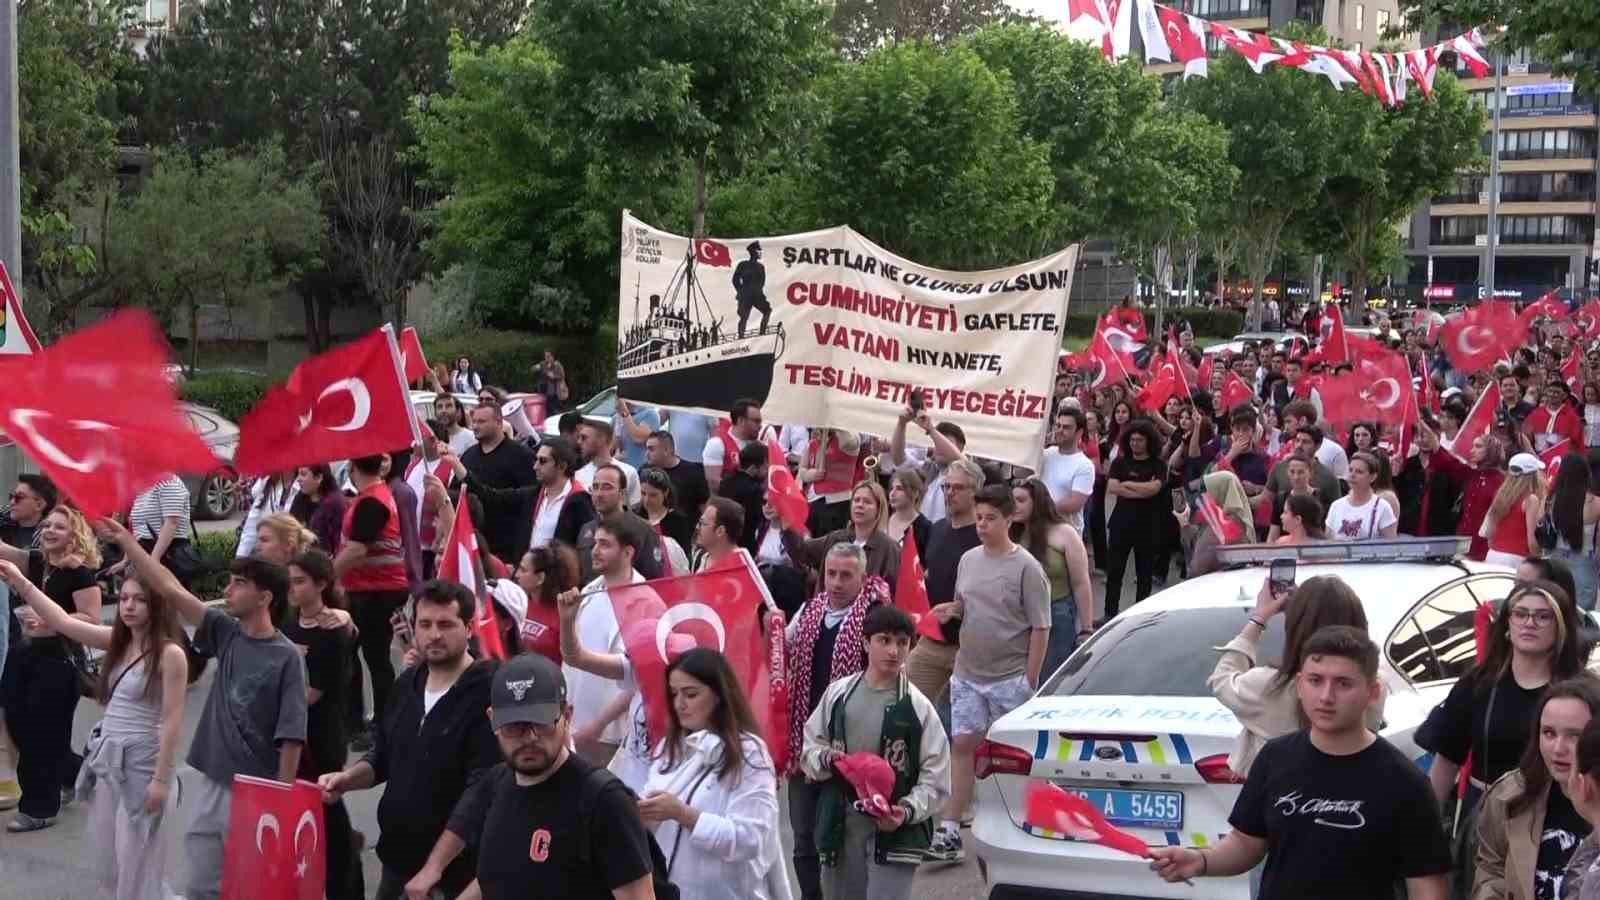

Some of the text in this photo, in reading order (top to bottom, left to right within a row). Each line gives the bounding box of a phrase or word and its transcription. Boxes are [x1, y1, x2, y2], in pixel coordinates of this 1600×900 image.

[783, 246, 877, 275] ŞARTLAR
[880, 262, 902, 282] NE
[989, 269, 1068, 293] OLSUN!
[786, 281, 1059, 335] CUMHURİYETİ GAFLETE,
[814, 322, 1002, 376] VATANI HIYANETE,
[784, 363, 872, 397] TESLİM
[1104, 792, 1115, 815] A
[1131, 794, 1177, 819] 5455
